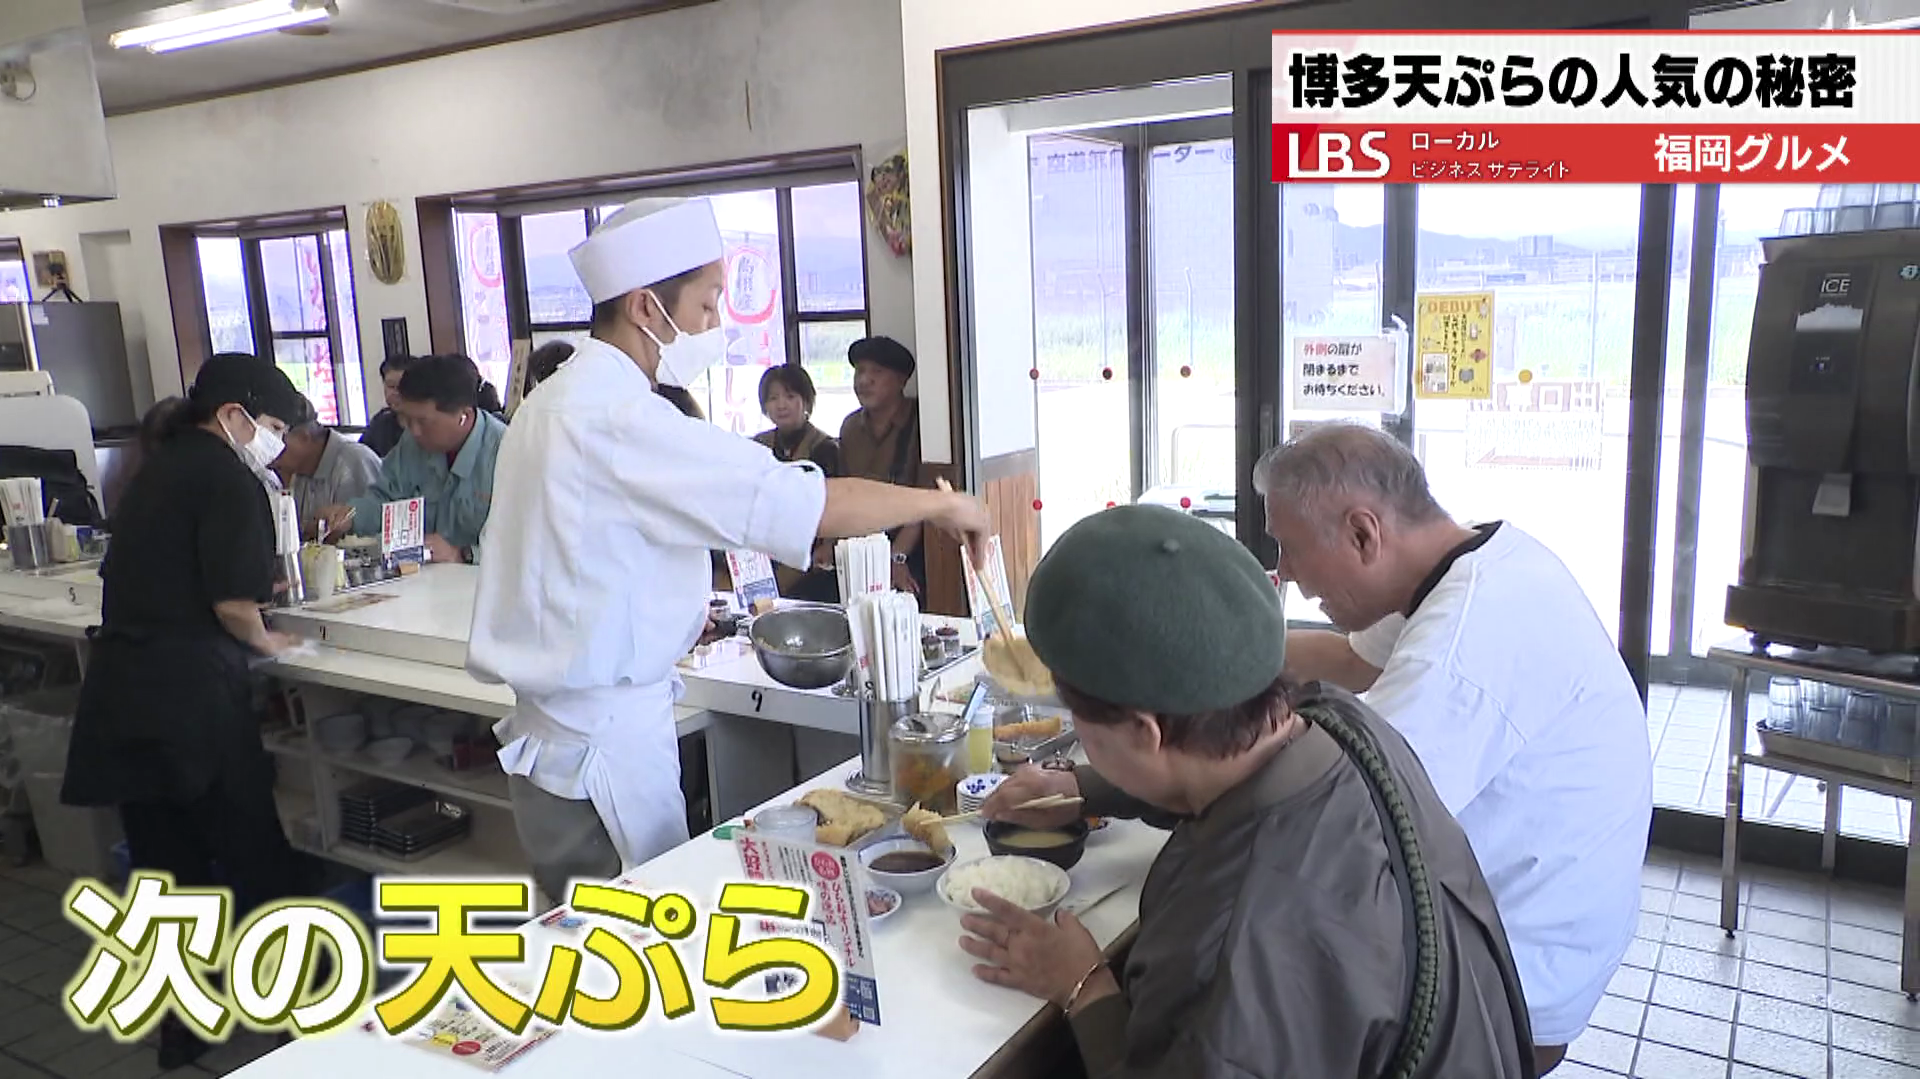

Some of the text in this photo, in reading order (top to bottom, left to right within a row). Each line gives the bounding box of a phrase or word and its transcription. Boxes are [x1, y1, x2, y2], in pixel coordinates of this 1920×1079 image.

[1820, 278, 1852, 293] ICE
[1303, 342, 1363, 357] 外側の扉が
[1302, 362, 1361, 378] 閉まるまで
[751, 689, 763, 713] 9
